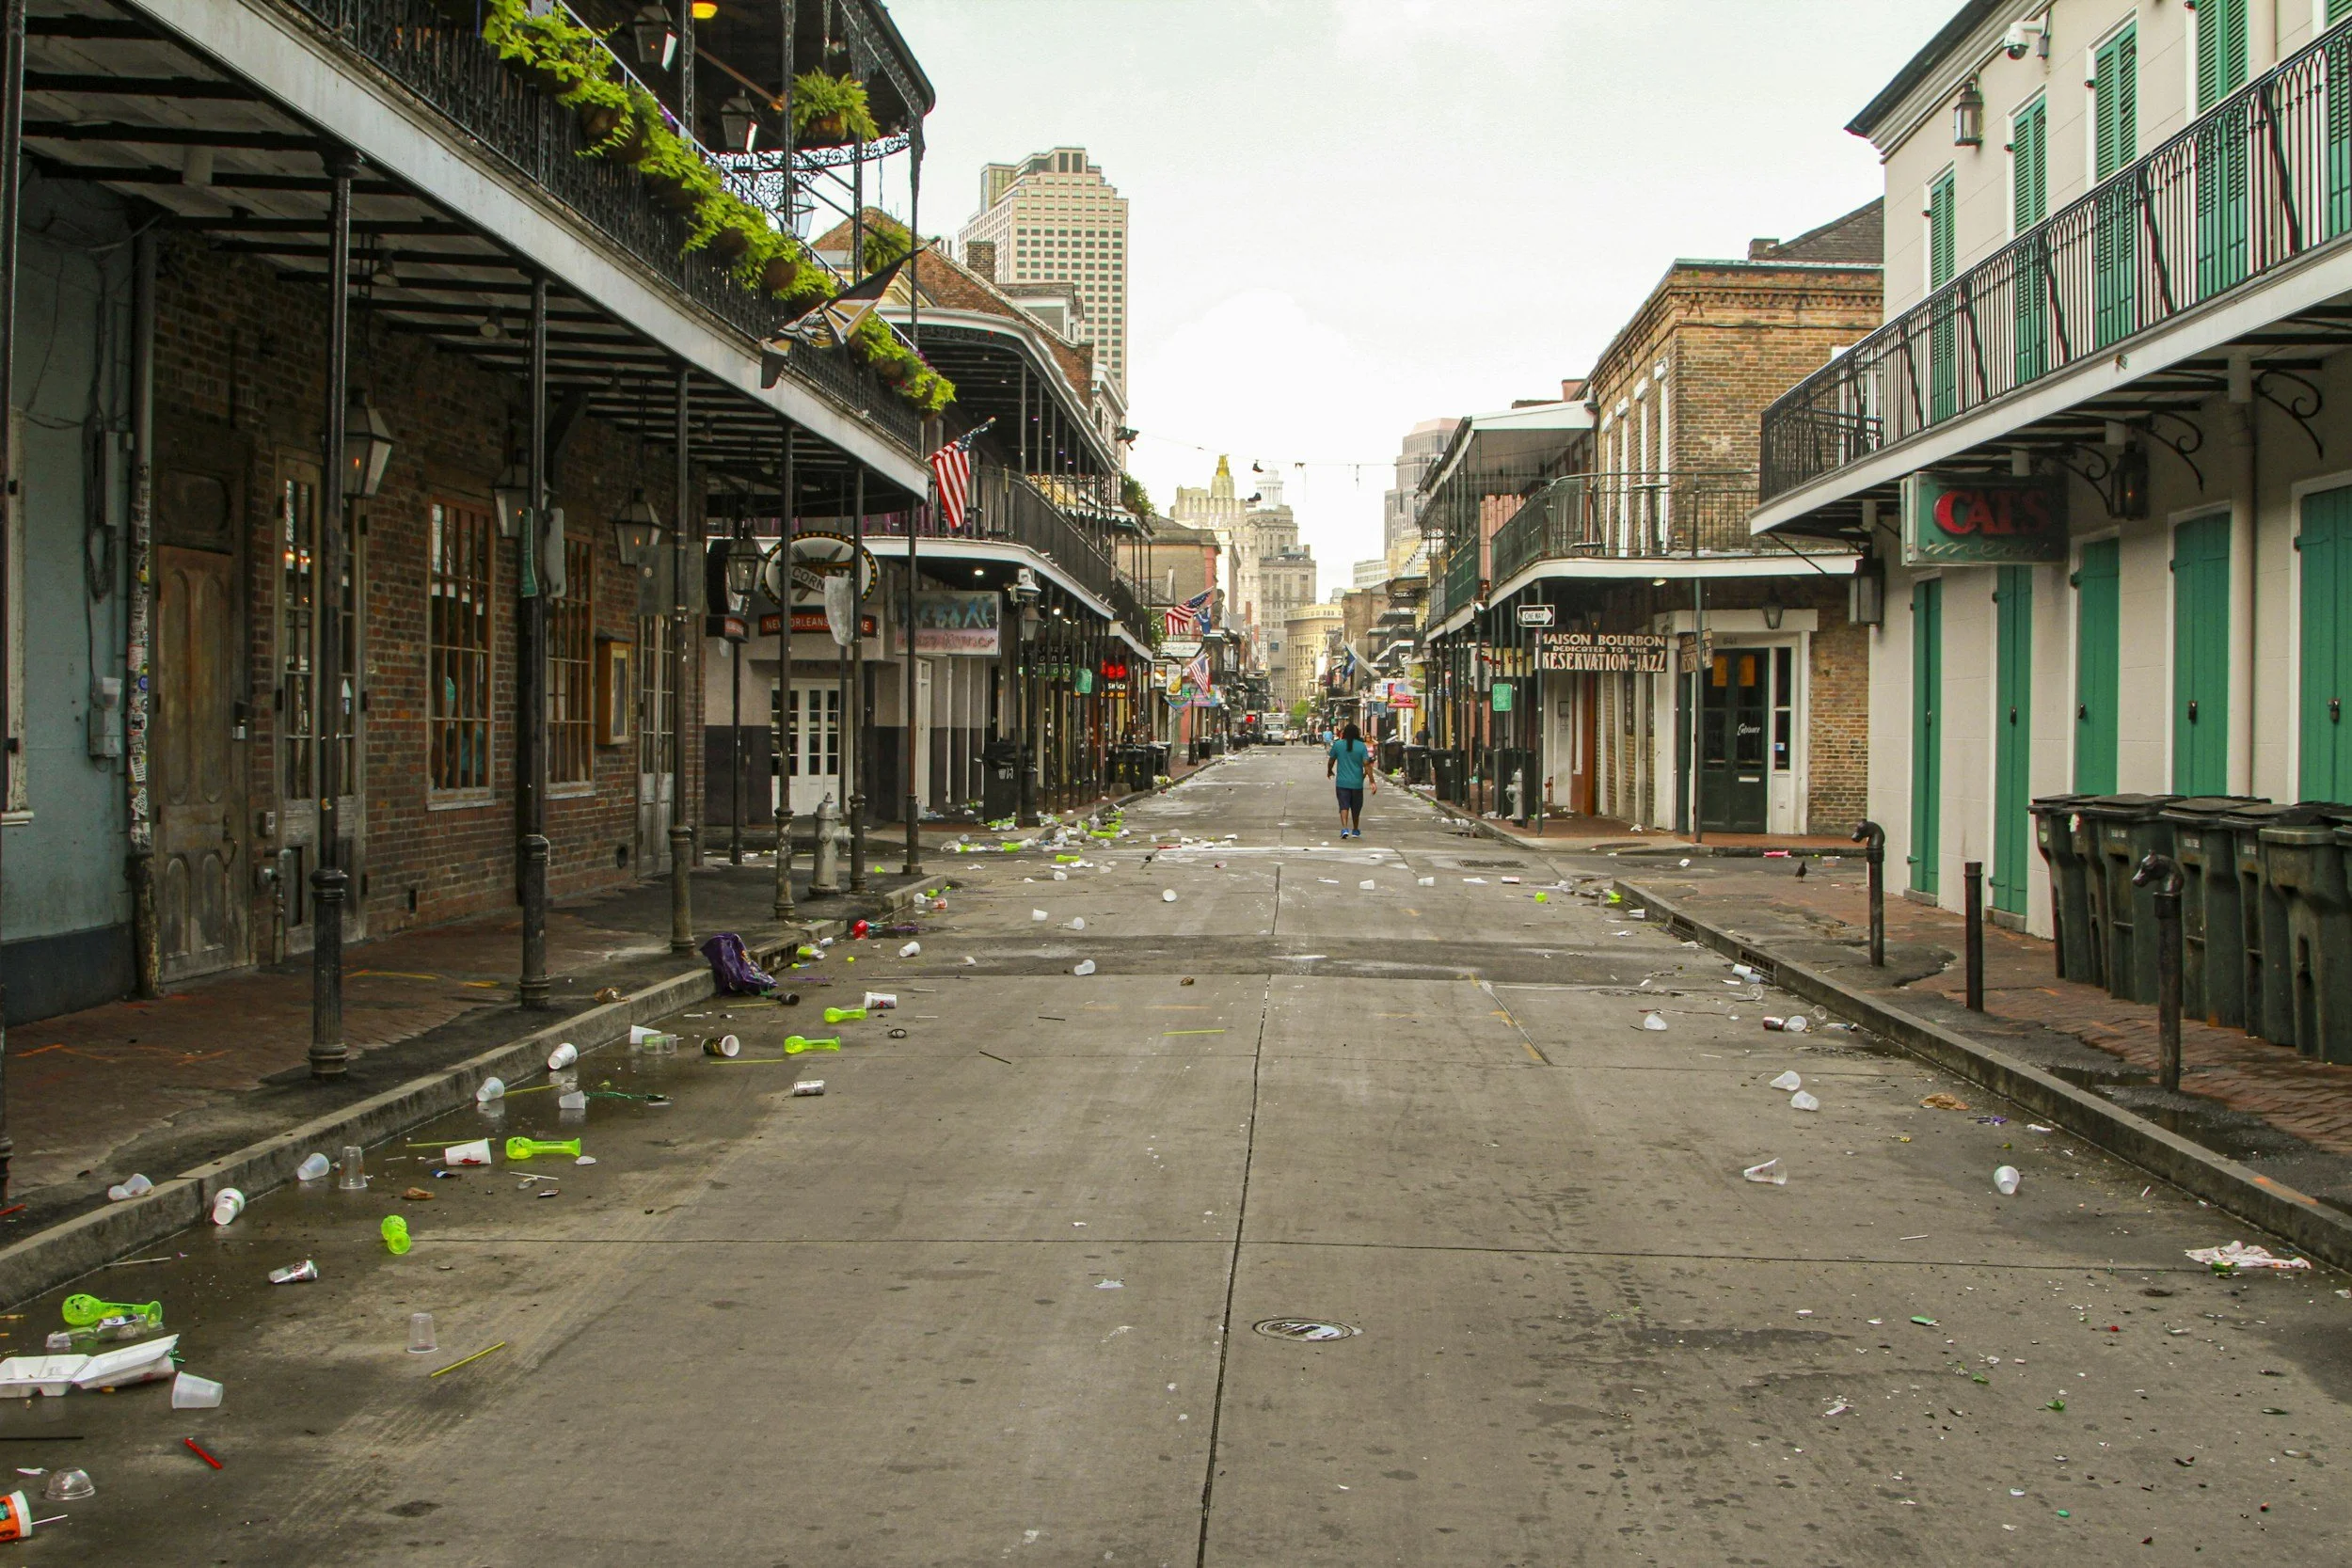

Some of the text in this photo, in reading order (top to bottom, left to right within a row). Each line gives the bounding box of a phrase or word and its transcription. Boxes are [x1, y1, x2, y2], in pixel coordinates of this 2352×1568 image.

[1933, 489, 2053, 535] CATS
[792, 567, 825, 590] CORN
[1524, 611, 1544, 620] ONE WAY
[1597, 634, 1665, 647] BOURBON
[1634, 650, 1665, 672] JAZZ
